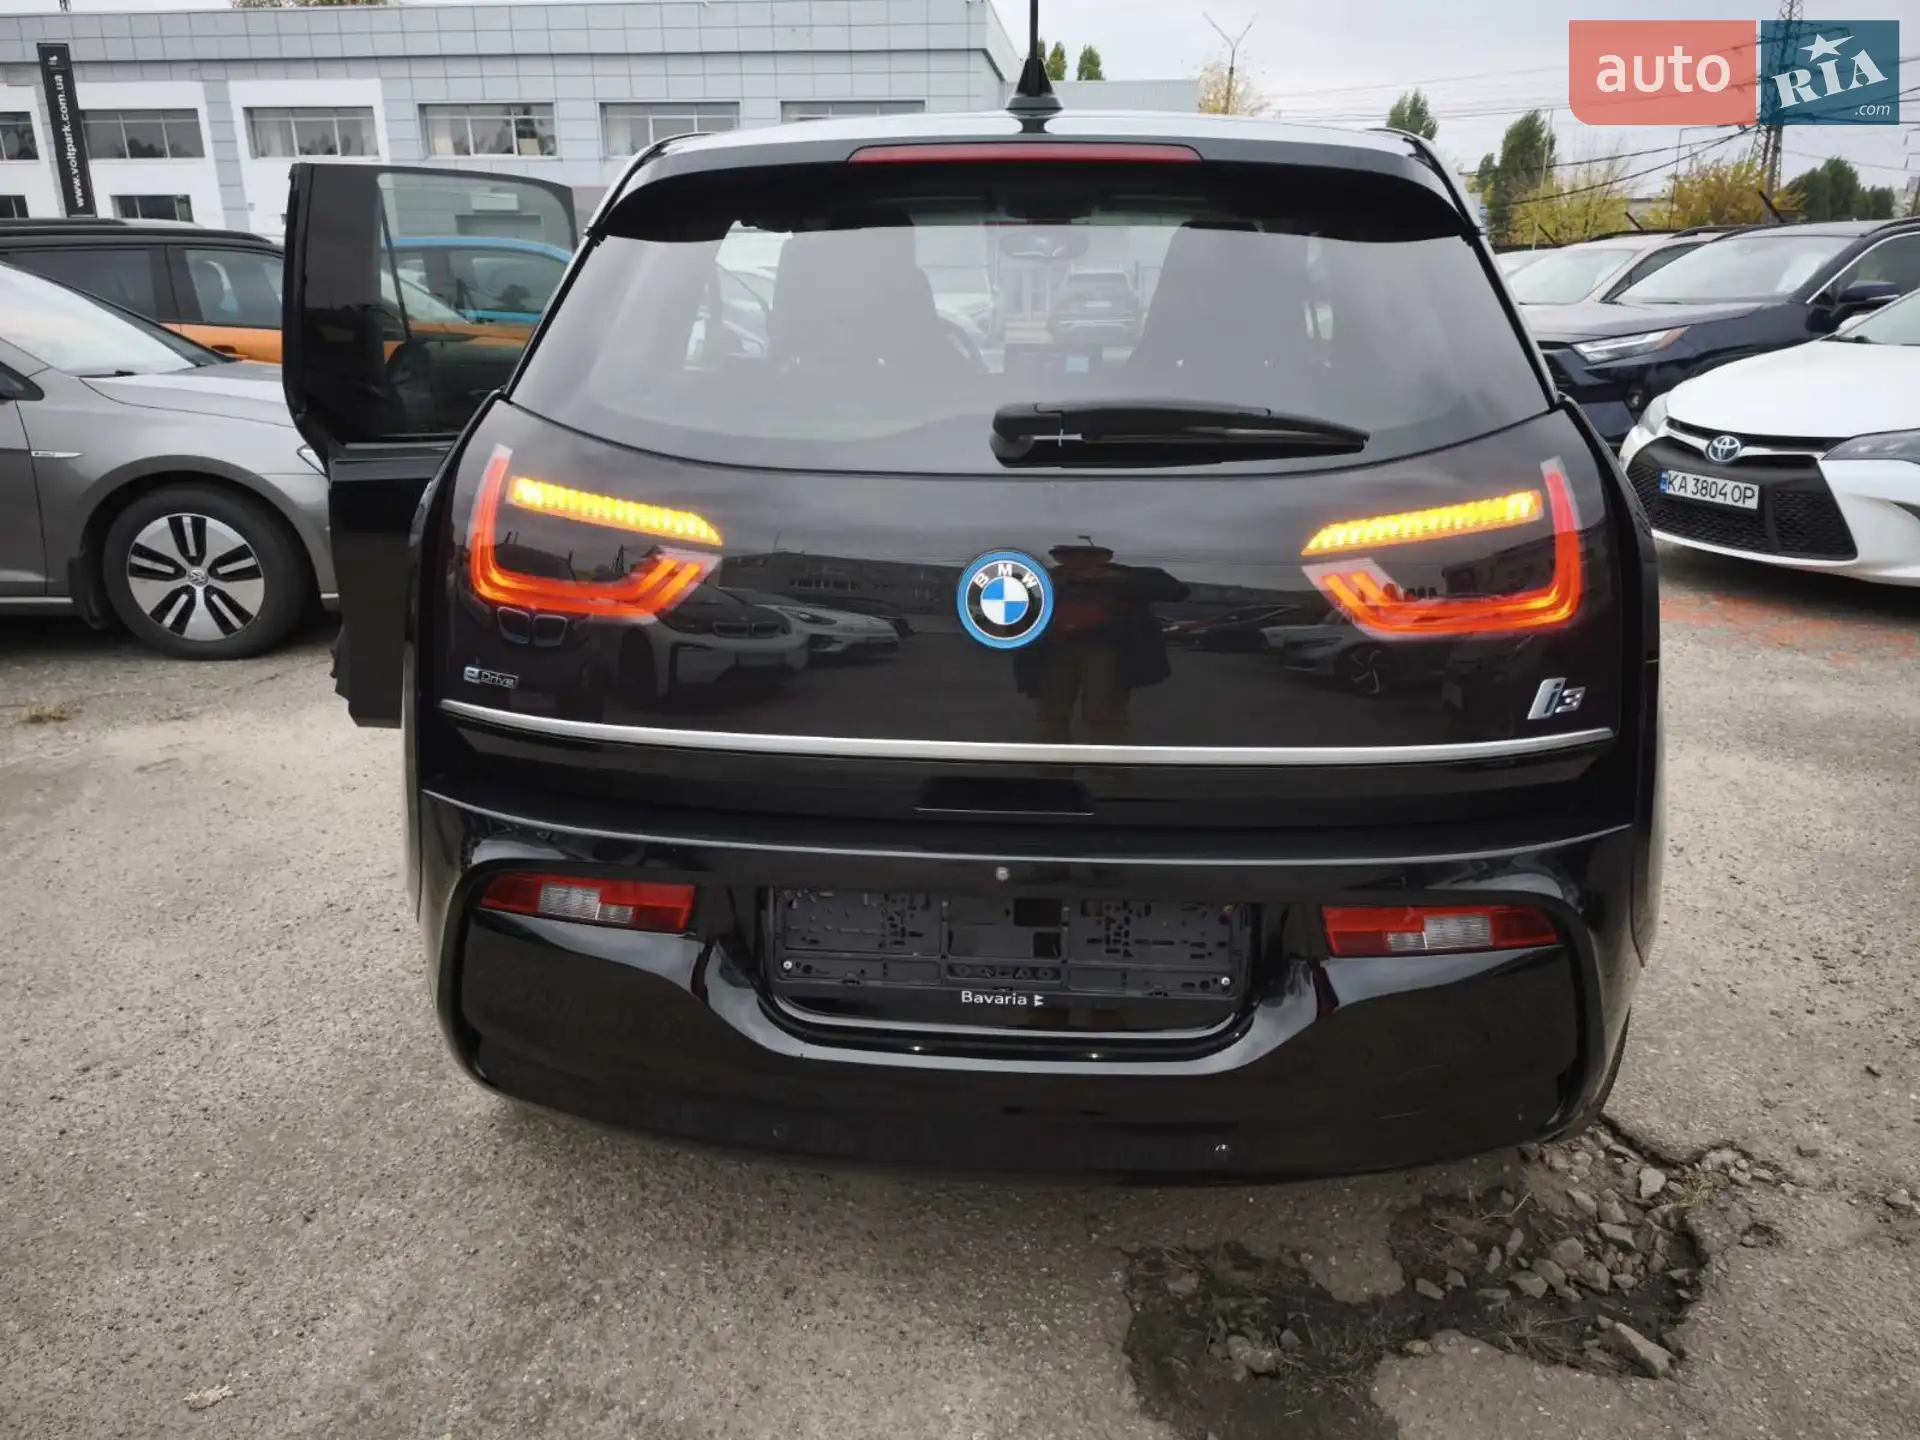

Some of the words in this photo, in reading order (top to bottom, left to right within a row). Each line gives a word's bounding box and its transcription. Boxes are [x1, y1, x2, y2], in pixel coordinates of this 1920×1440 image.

[54, 75, 85, 208] www.voltpark.com.ua
[1668, 474, 1687, 493] KA
[1691, 478, 1727, 501] 3804
[1731, 485, 1755, 505] OP
[974, 563, 1038, 588] BMW
[1527, 677, 1586, 720] i3
[961, 990, 1027, 1006] Bavaria
